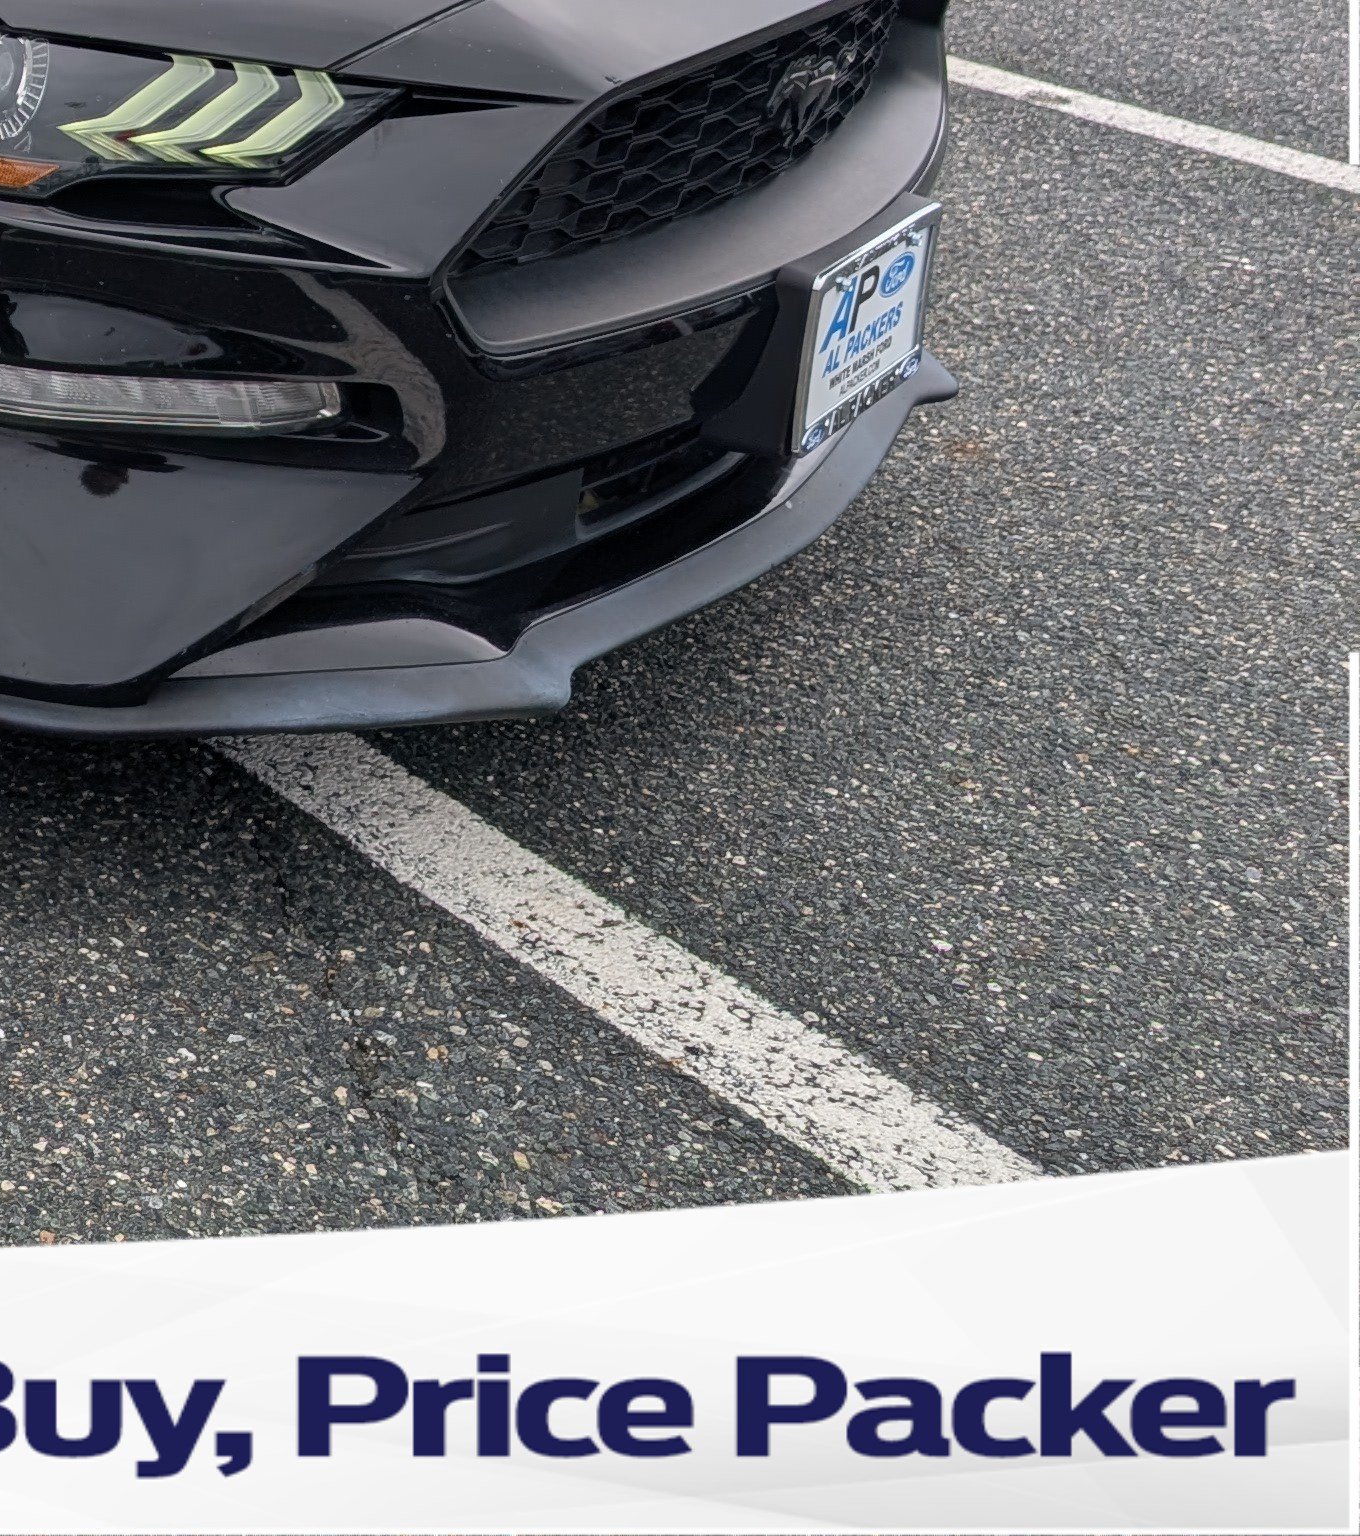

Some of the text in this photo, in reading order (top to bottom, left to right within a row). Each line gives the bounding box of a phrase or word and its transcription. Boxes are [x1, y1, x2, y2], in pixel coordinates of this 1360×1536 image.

[819, 265, 880, 353] AP
[822, 344, 841, 378] AL
[829, 365, 851, 390] WHITE
